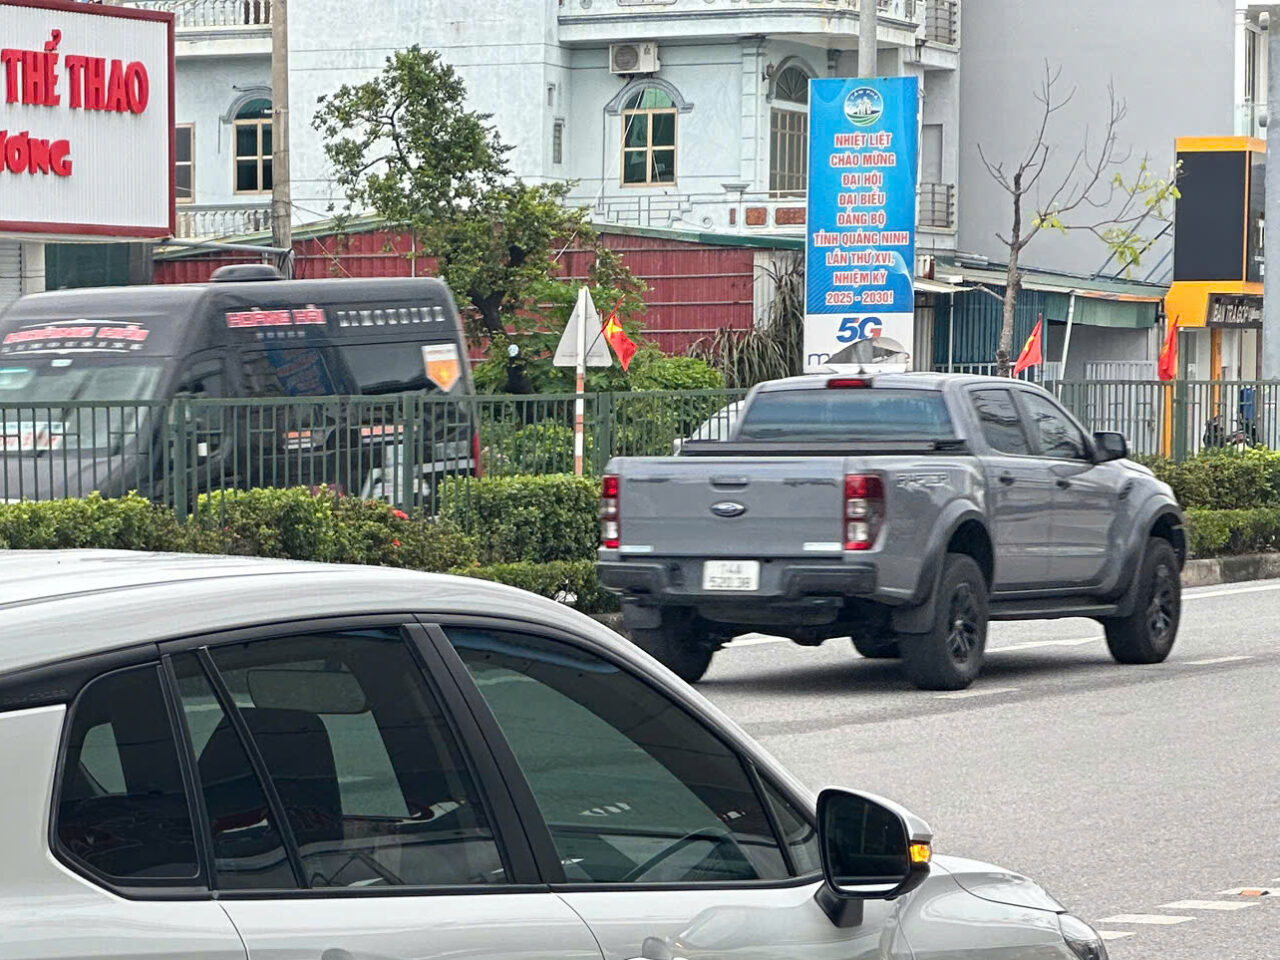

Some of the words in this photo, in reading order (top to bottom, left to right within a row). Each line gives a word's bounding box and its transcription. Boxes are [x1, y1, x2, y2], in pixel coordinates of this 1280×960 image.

[1, 29, 61, 107] THỂ
[65, 54, 149, 115] THAO
[835, 132, 867, 149] NHIỆT
[868, 132, 892, 149] LIỆT
[830, 151, 860, 167] CHÀO
[862, 150, 896, 167] MỪNG
[842, 173, 861, 189] ĐẠI
[863, 171, 883, 188] HỘI
[837, 207, 868, 226] ĐẢNG
[870, 210, 886, 228] BỘ
[814, 230, 840, 247] TỈNH
[841, 229, 879, 247] QUẢNG
[880, 231, 909, 246] NINH
[834, 269, 870, 287] NHIỆM
[825, 292, 853, 305] 2025
[862, 290, 893, 305] 2030!
[836, 317, 882, 343] 5G
